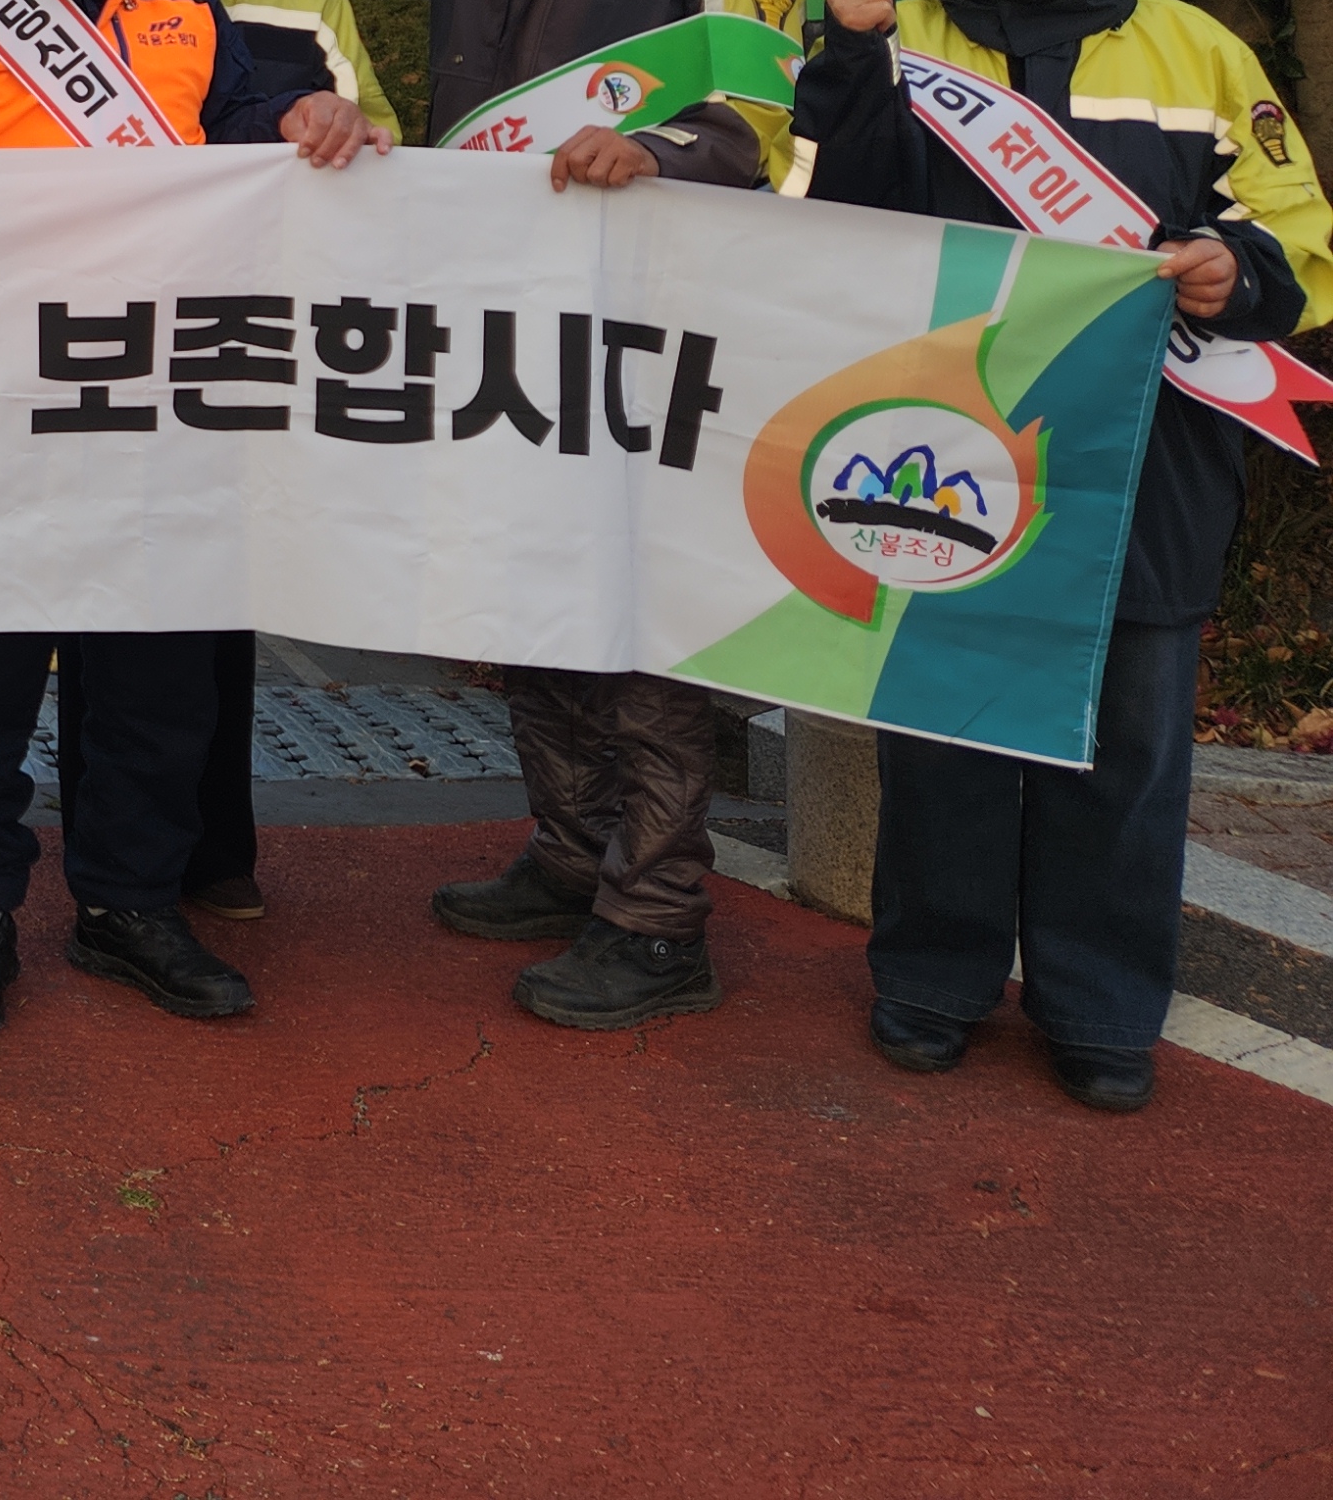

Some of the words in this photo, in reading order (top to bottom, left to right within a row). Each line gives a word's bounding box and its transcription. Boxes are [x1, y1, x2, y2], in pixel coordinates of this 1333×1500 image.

[987, 121, 1093, 225] 작은
[31, 293, 724, 472] 보존합시다
[850, 527, 955, 568] 산불조심
